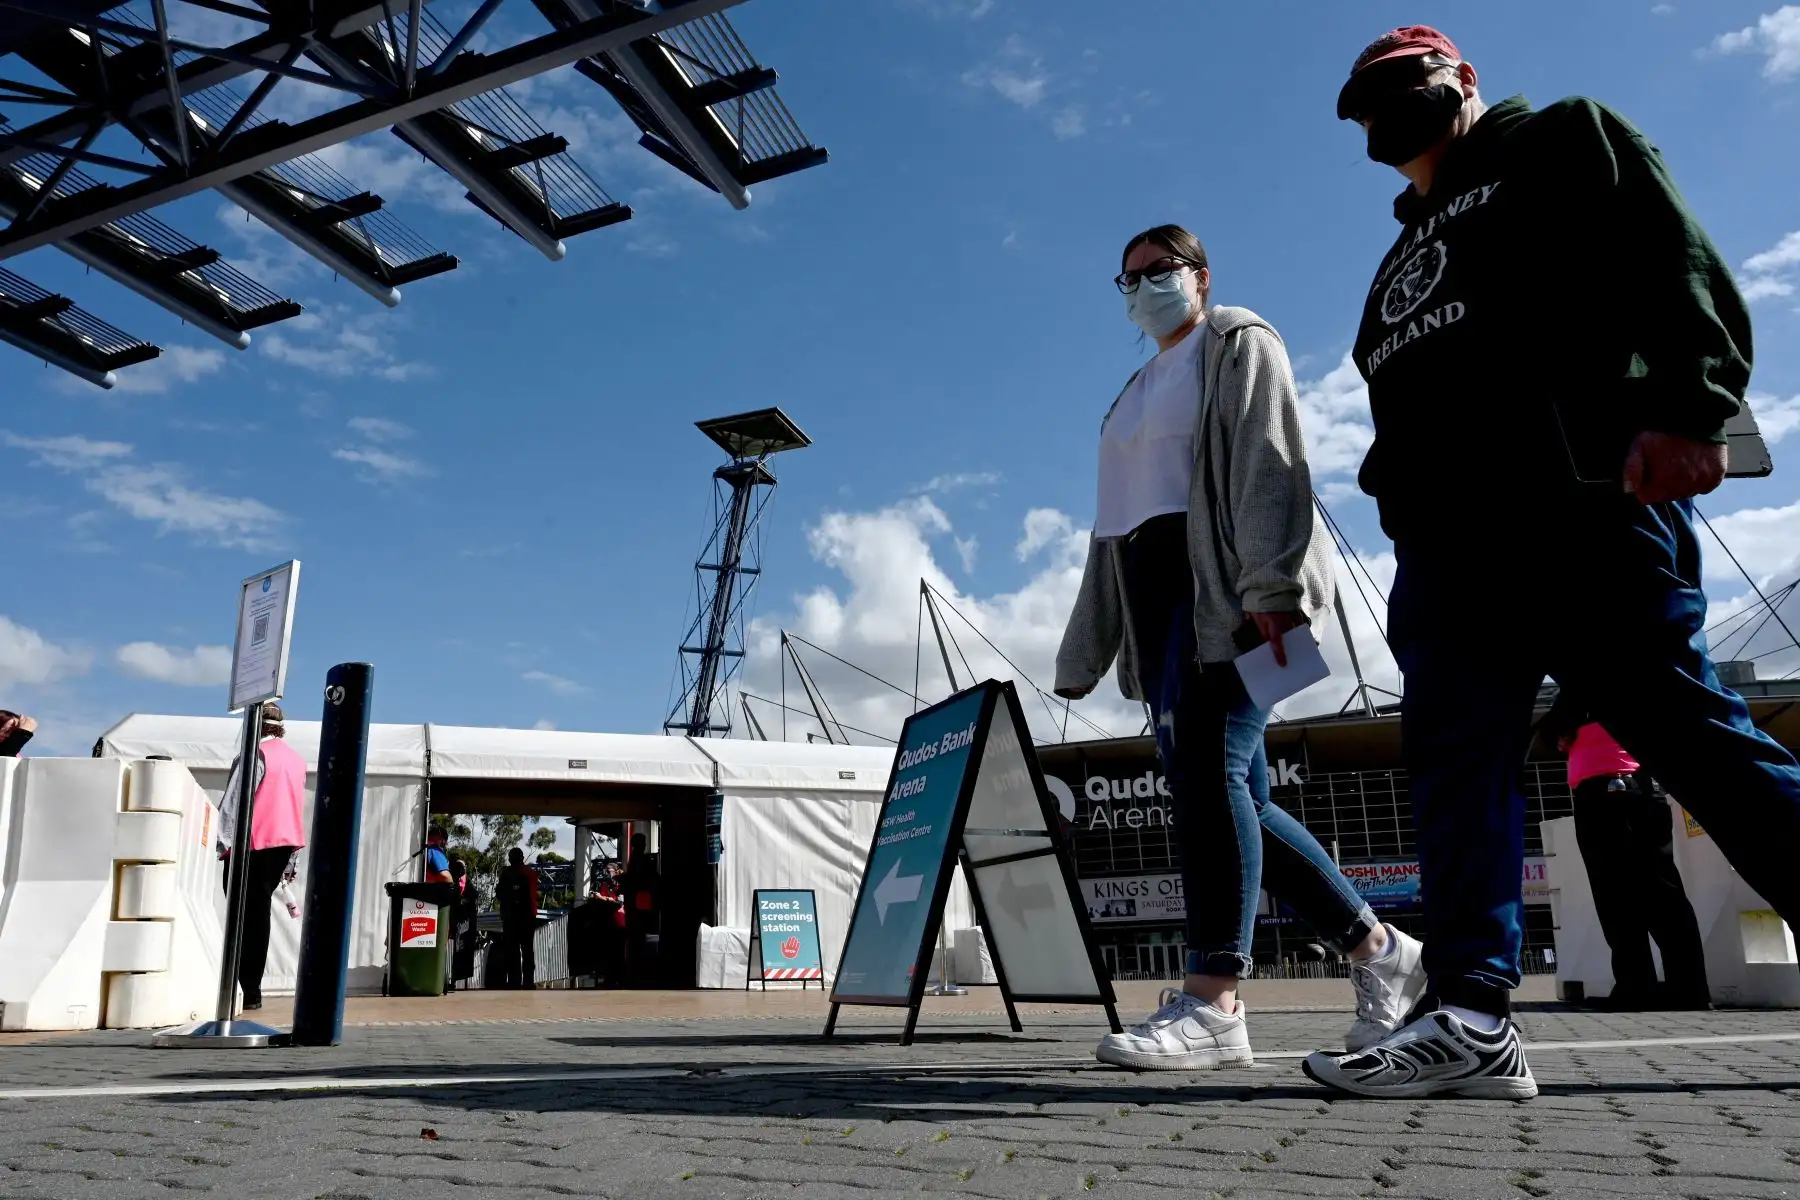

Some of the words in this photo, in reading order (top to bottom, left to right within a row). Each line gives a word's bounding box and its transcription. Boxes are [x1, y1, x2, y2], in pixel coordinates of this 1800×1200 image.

[1367, 301, 1466, 377] IRELAND
[897, 741, 939, 771] Qudos
[939, 722, 976, 755] Bank
[887, 775, 927, 803] Arena
[881, 815, 897, 829] NSW
[896, 808, 916, 823] Health
[876, 832, 911, 847] Vaccination
[910, 824, 932, 838] Centre
[1093, 881, 1149, 898] KINGS
[1158, 879, 1184, 895] OF
[1370, 876, 1384, 888] The
[760, 900, 790, 910] Zone
[792, 900, 800, 910] 2
[1141, 899, 1183, 909] SATURDAY
[761, 912, 813, 923] screening
[762, 923, 801, 932] station
